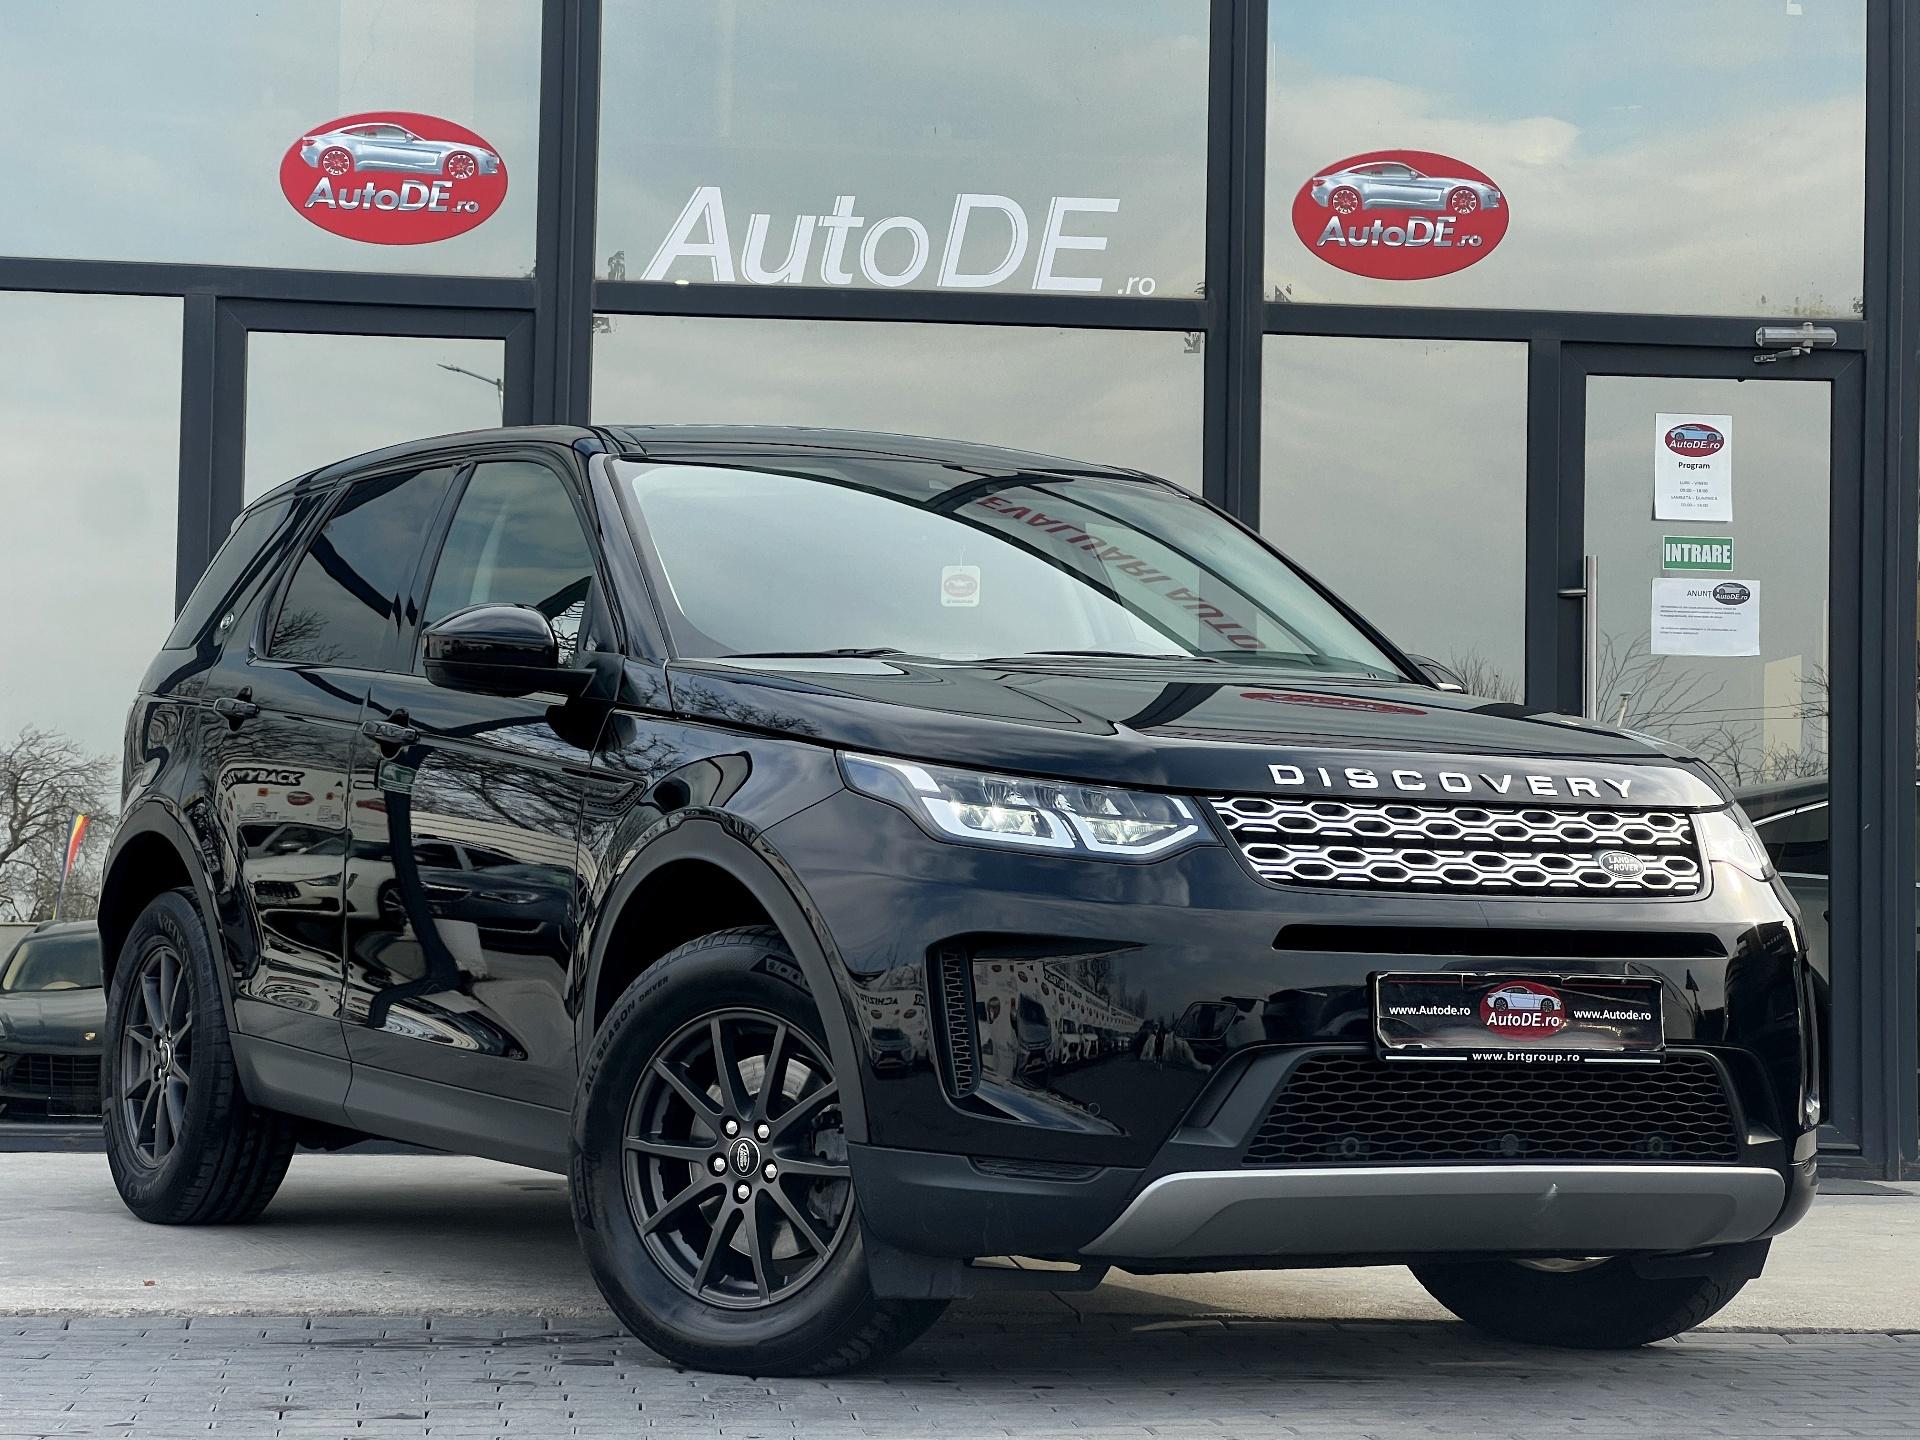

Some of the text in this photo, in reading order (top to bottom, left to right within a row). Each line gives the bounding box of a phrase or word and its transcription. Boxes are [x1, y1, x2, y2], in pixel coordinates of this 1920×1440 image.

[1669, 440, 1721, 450] AutoDE.ro
[1678, 461, 1711, 471] Program
[1665, 543, 1731, 564] INTRARE
[1268, 764, 1632, 798] DISCOVERY
[1608, 856, 1630, 864] LAND
[1613, 863, 1639, 872] ROVER
[1389, 1005, 1471, 1016] www.Autode.ro
[1573, 1009, 1652, 1021] www.Autode.ro
[596, 1000, 636, 1061] SEASON
[638, 975, 669, 1003] DRIVER
[1487, 1012, 1561, 1028] AutoDE.ro
[1472, 1051, 1580, 1064] www.brtgroup.ro
